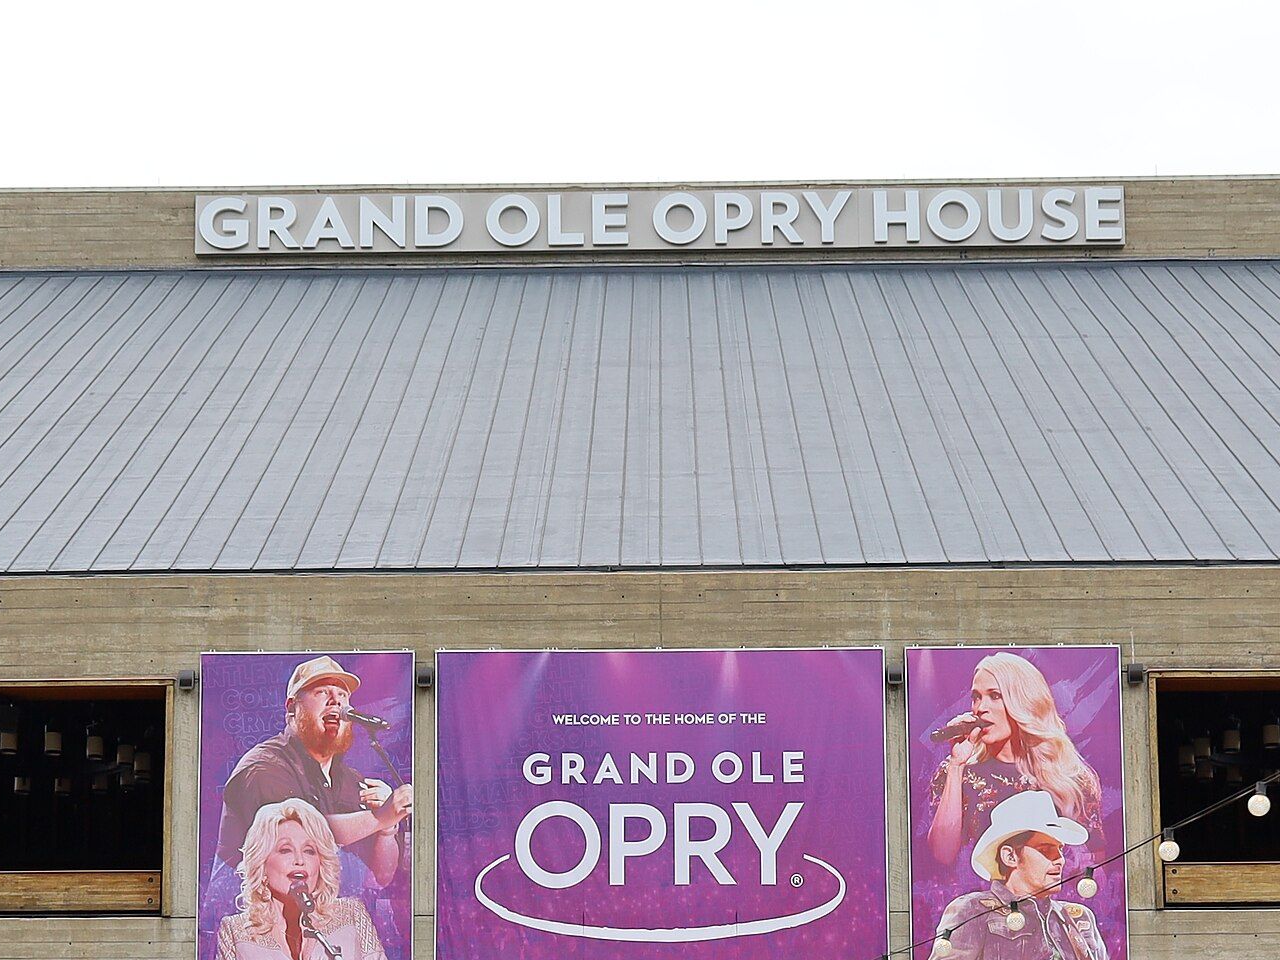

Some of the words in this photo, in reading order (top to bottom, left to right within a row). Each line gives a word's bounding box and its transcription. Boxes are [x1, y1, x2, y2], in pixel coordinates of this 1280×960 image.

[198, 195, 464, 250] GRAND
[485, 192, 629, 247] OLE
[652, 190, 853, 245] OPRY
[872, 187, 1123, 243] HOUSE
[552, 714, 620, 725] WELCOME
[623, 714, 642, 725] TO
[645, 714, 671, 725] THE
[674, 713, 715, 724] HOME
[717, 713, 737, 724] OF
[739, 713, 766, 724] THE
[522, 752, 695, 785] GRAND
[711, 751, 805, 784] OLE
[514, 800, 805, 889] OPRY
